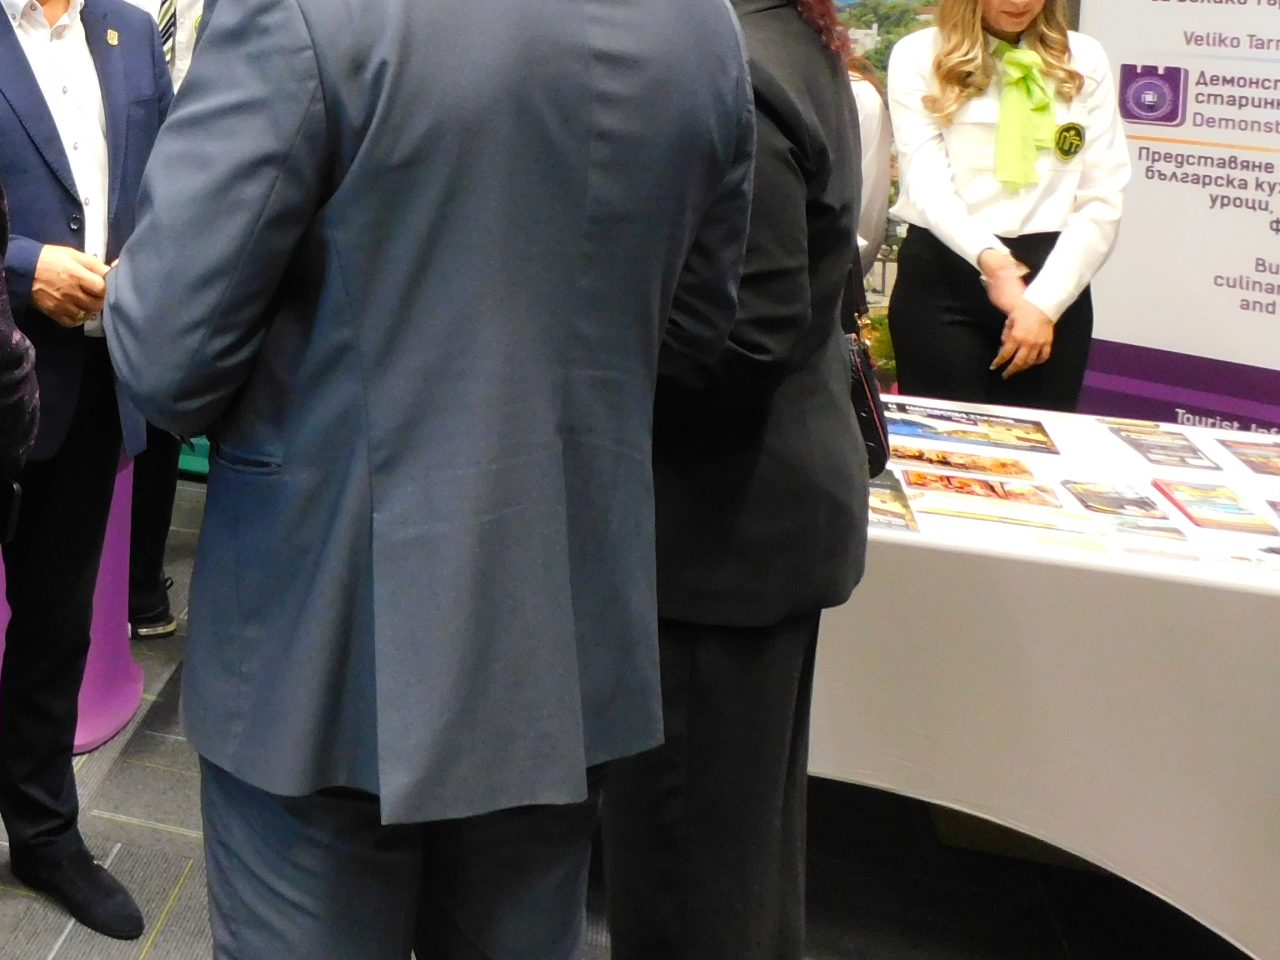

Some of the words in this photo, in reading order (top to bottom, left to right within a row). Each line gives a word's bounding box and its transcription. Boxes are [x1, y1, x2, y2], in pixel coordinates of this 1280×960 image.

[1183, 30, 1241, 49] Veliko
[1137, 146, 1275, 174] Представяне
[1144, 165, 1249, 190] българска
[1239, 298, 1277, 315] and
